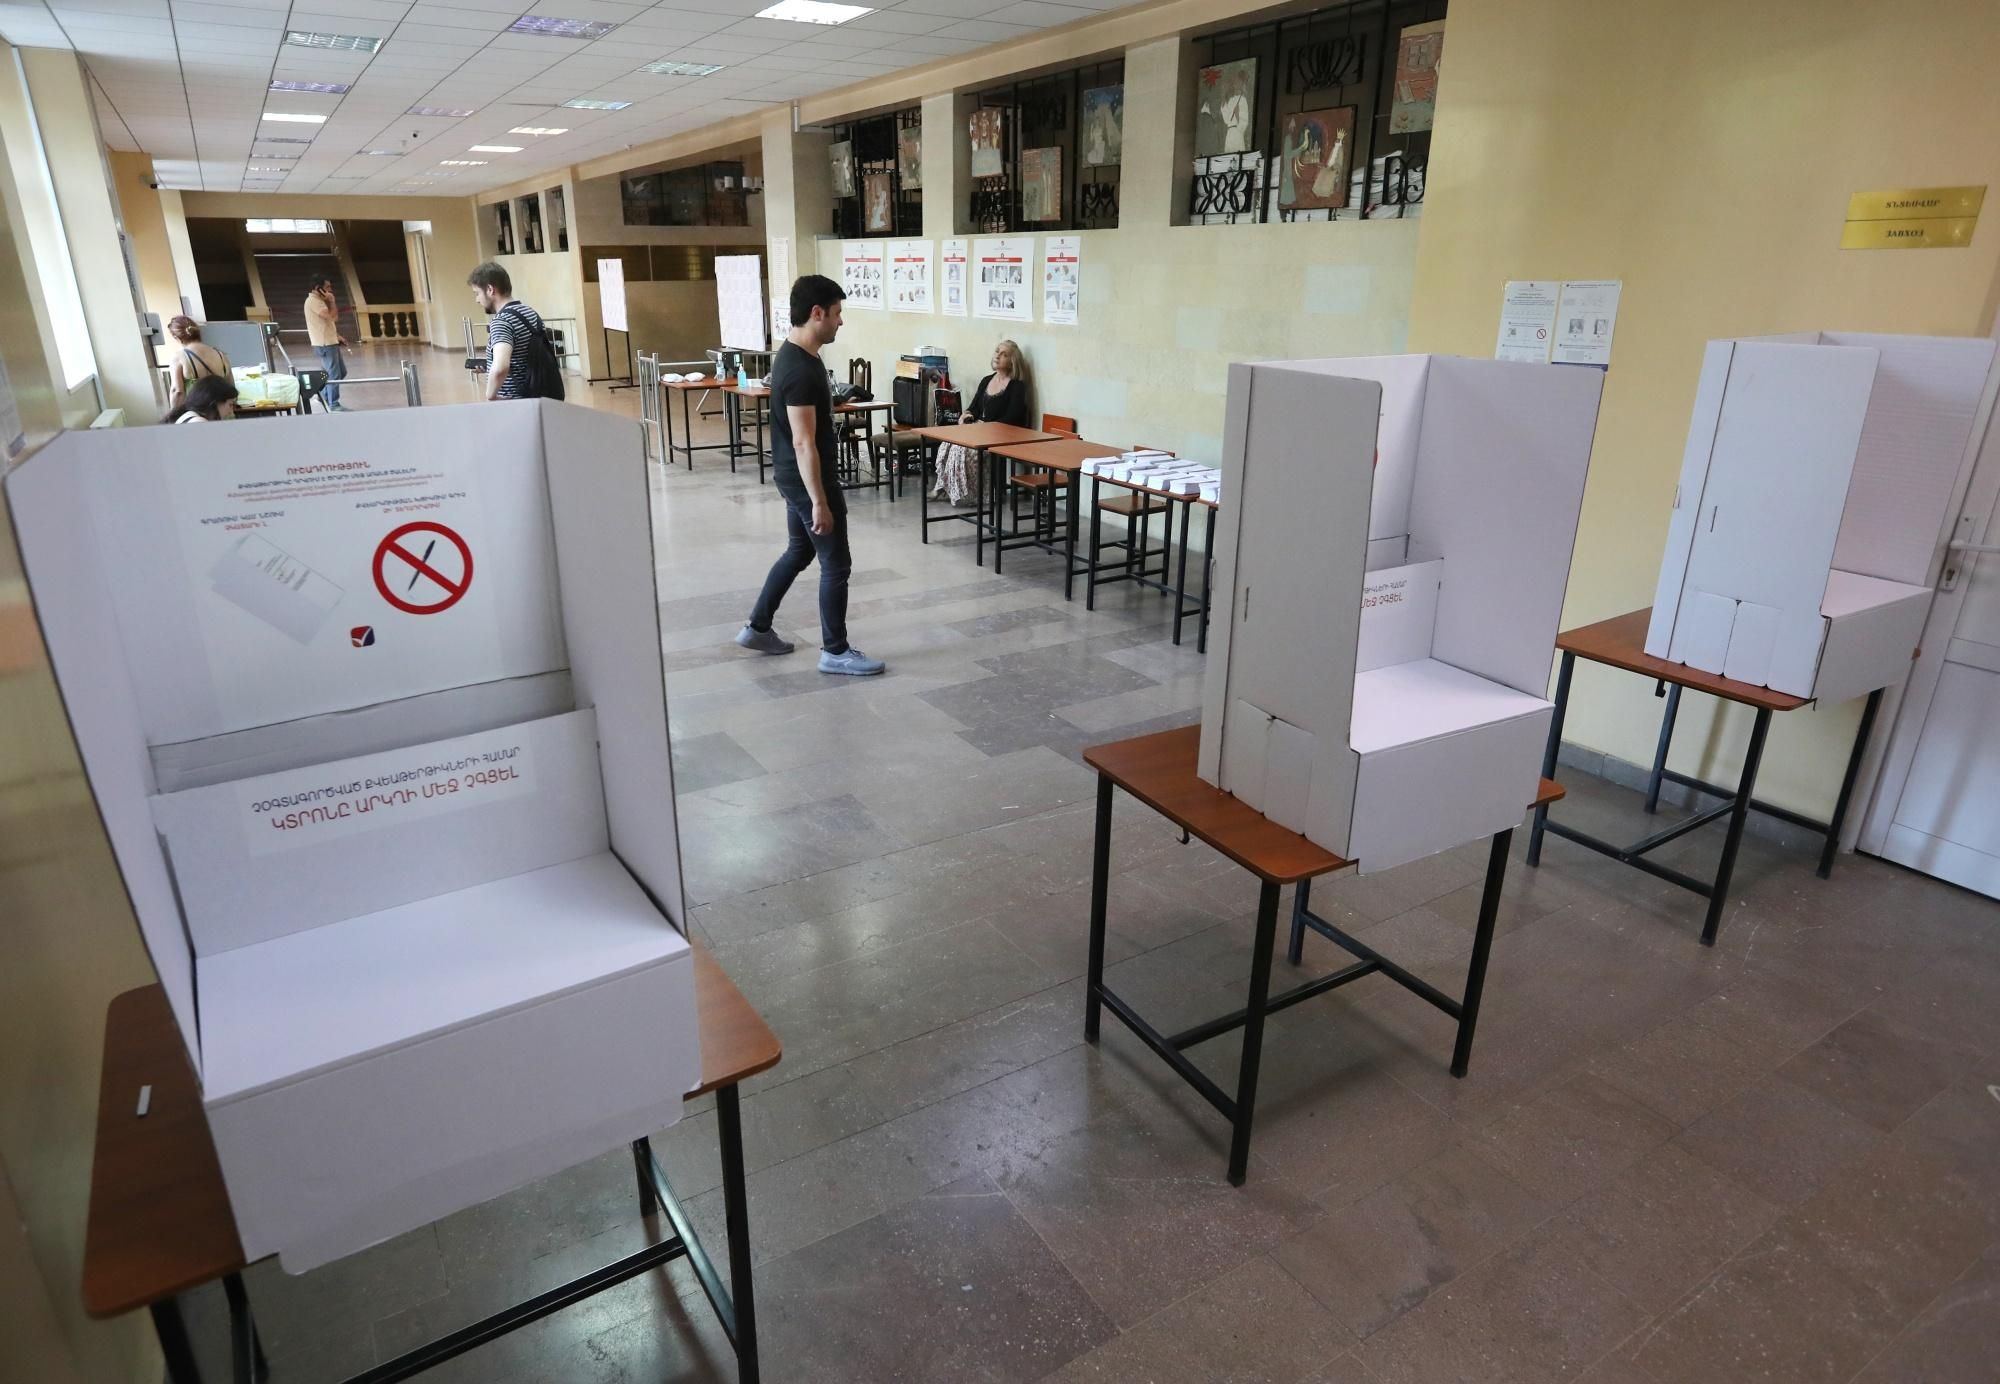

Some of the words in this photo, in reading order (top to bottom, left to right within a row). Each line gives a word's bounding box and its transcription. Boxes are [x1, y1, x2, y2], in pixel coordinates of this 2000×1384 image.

[286, 461, 371, 475] ՈՒՇԱԴՐՈՒԹՅՈՒՆ
[251, 781, 362, 813] ՉՕԳՏԱԳՈՐԾՎԱԾ
[365, 758, 480, 790] ՔՎԵԱԹԵՐԹԻԿՆԵՐԻ
[482, 746, 520, 762] ՀԱՄԱՐ
[271, 802, 351, 831] ԿՏՐՈՆԸ
[355, 789, 418, 813] ԱՐԿՂԻ
[421, 778, 460, 799] ՄԵՋ
[464, 765, 519, 788] ՉԳՑԵԼ
